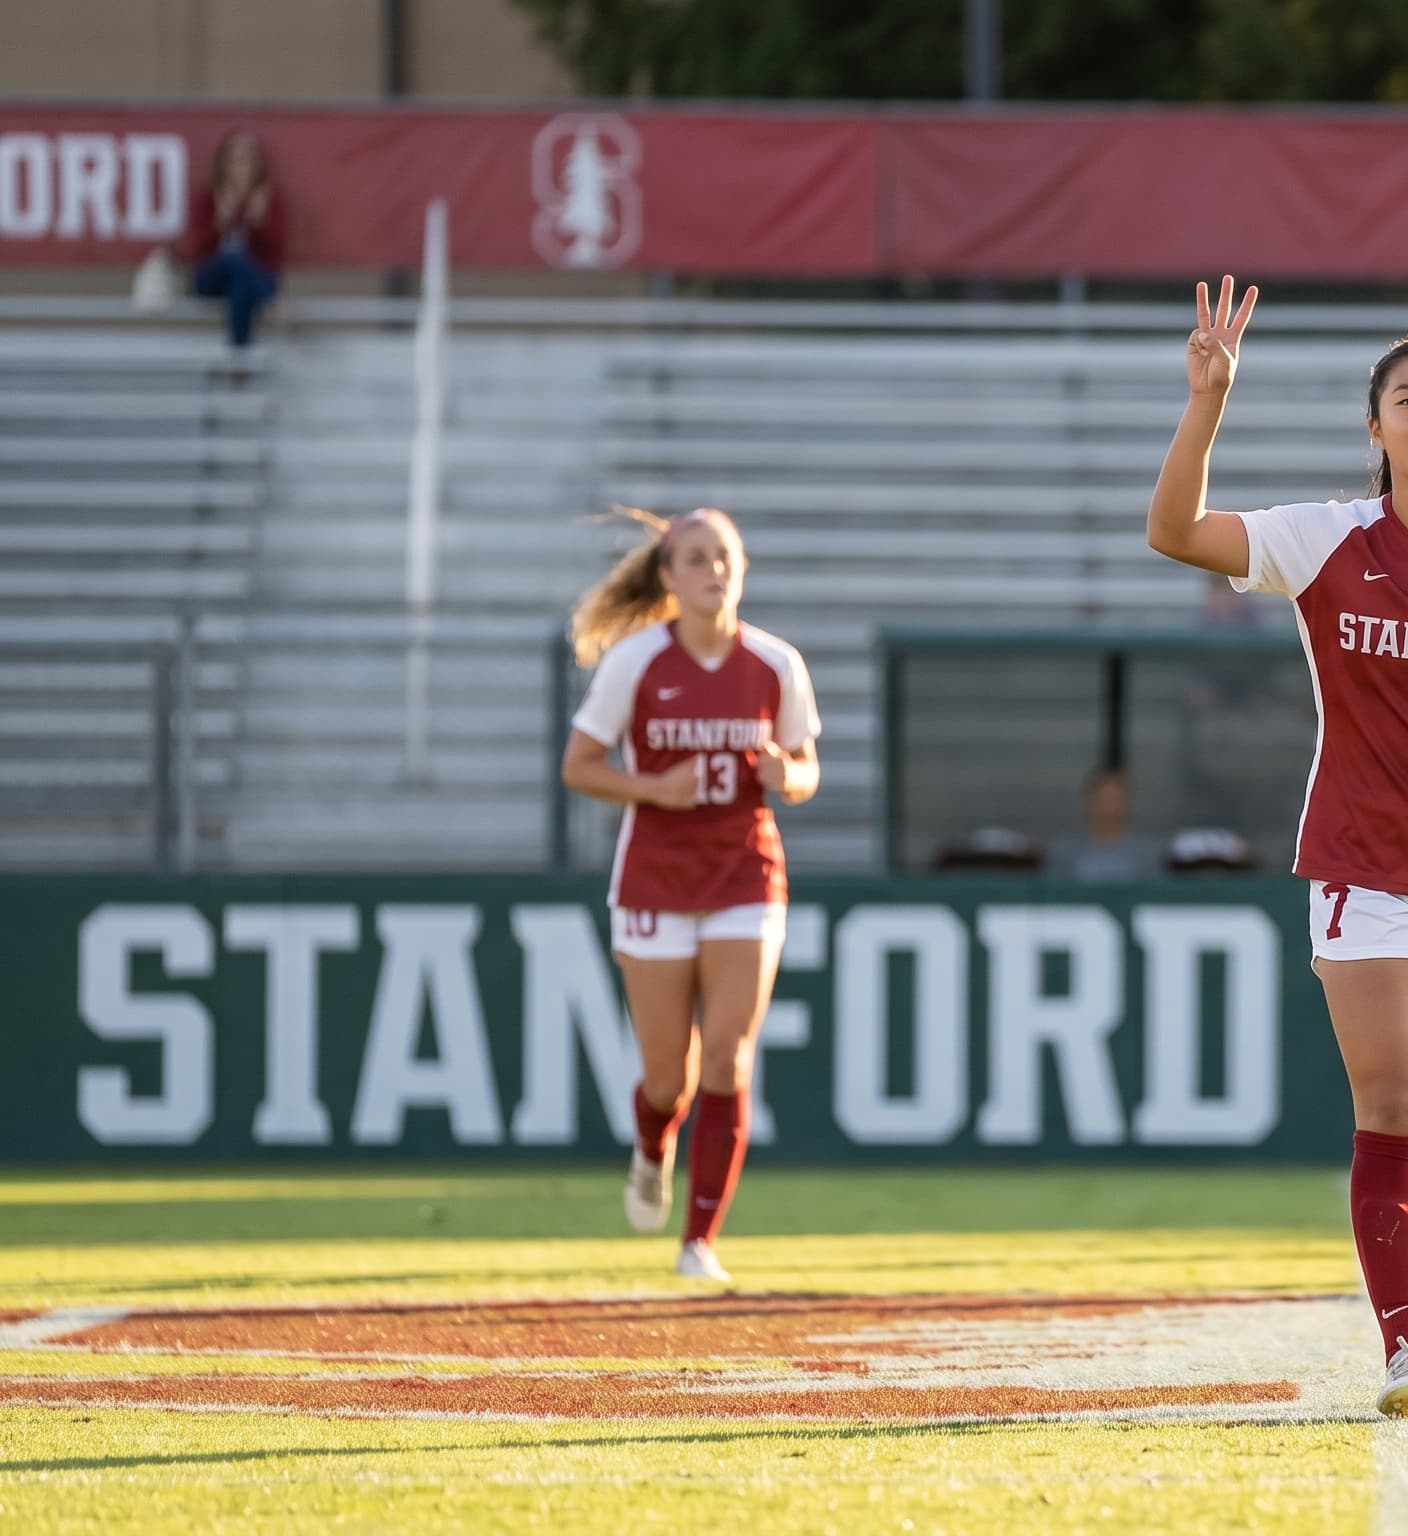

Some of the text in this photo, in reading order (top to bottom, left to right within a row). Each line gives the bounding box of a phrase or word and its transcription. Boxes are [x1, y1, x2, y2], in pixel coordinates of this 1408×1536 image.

[0, 132, 188, 238] ORD
[694, 751, 738, 805] 13
[1322, 883, 1351, 940] 7
